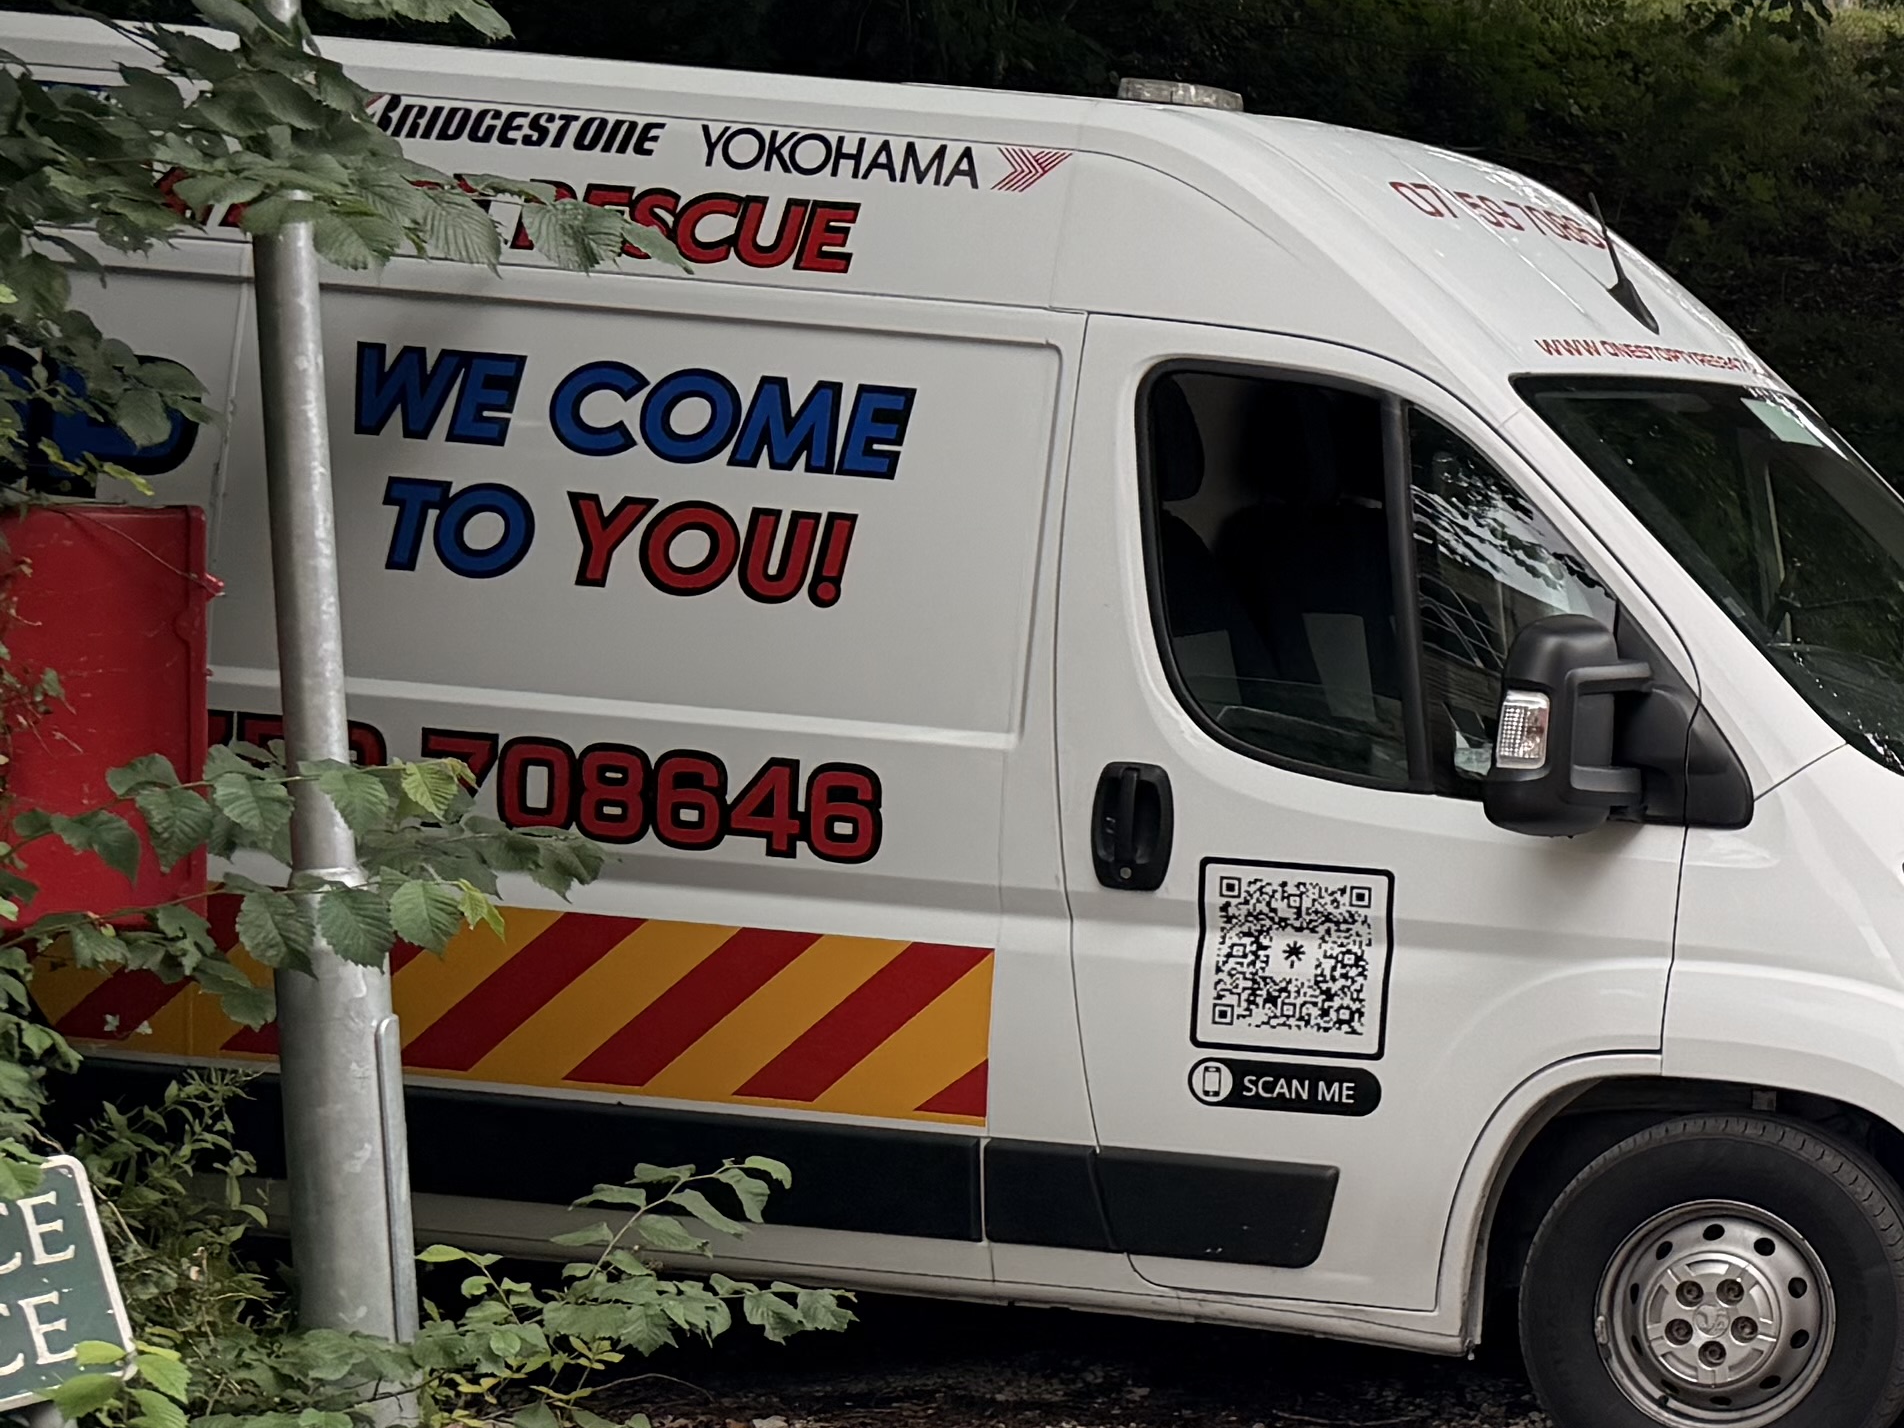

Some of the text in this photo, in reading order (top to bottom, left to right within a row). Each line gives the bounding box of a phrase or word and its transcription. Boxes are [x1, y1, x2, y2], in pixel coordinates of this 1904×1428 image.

[366, 94, 666, 157] BRIDGESTONE
[701, 124, 980, 190] YOKOHAMA
[354, 341, 917, 480] WE COME
[382, 476, 859, 608] TO YOU!
[421, 726, 883, 864] 708646
[1242, 1076, 1355, 1103] SCAN ME
